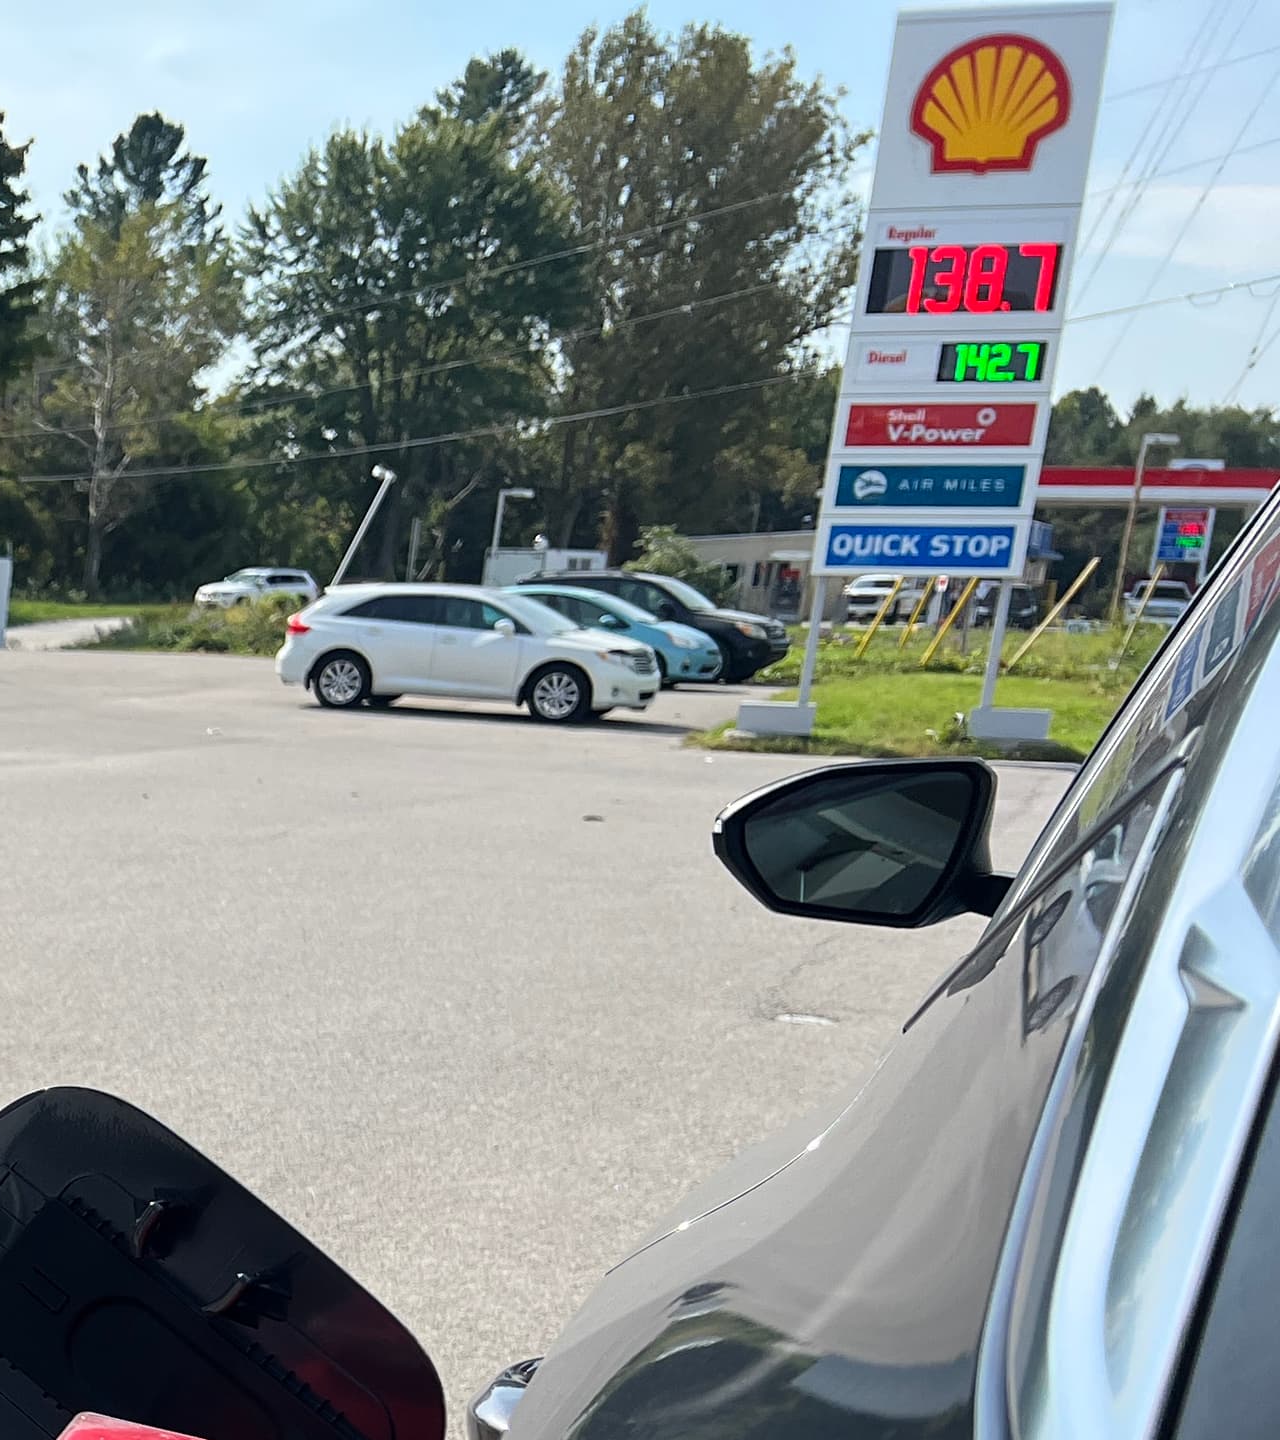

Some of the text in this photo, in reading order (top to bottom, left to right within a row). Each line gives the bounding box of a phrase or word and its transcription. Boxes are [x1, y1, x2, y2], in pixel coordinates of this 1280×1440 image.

[886, 226, 938, 242] Regular
[906, 243, 1058, 316] 138.7
[868, 342, 1041, 382] Diesel 142.7
[887, 408, 926, 423] Shell
[888, 423, 987, 442] V-Power
[898, 478, 1006, 493] AIR MILES
[831, 533, 1011, 558] QUICK STOP
